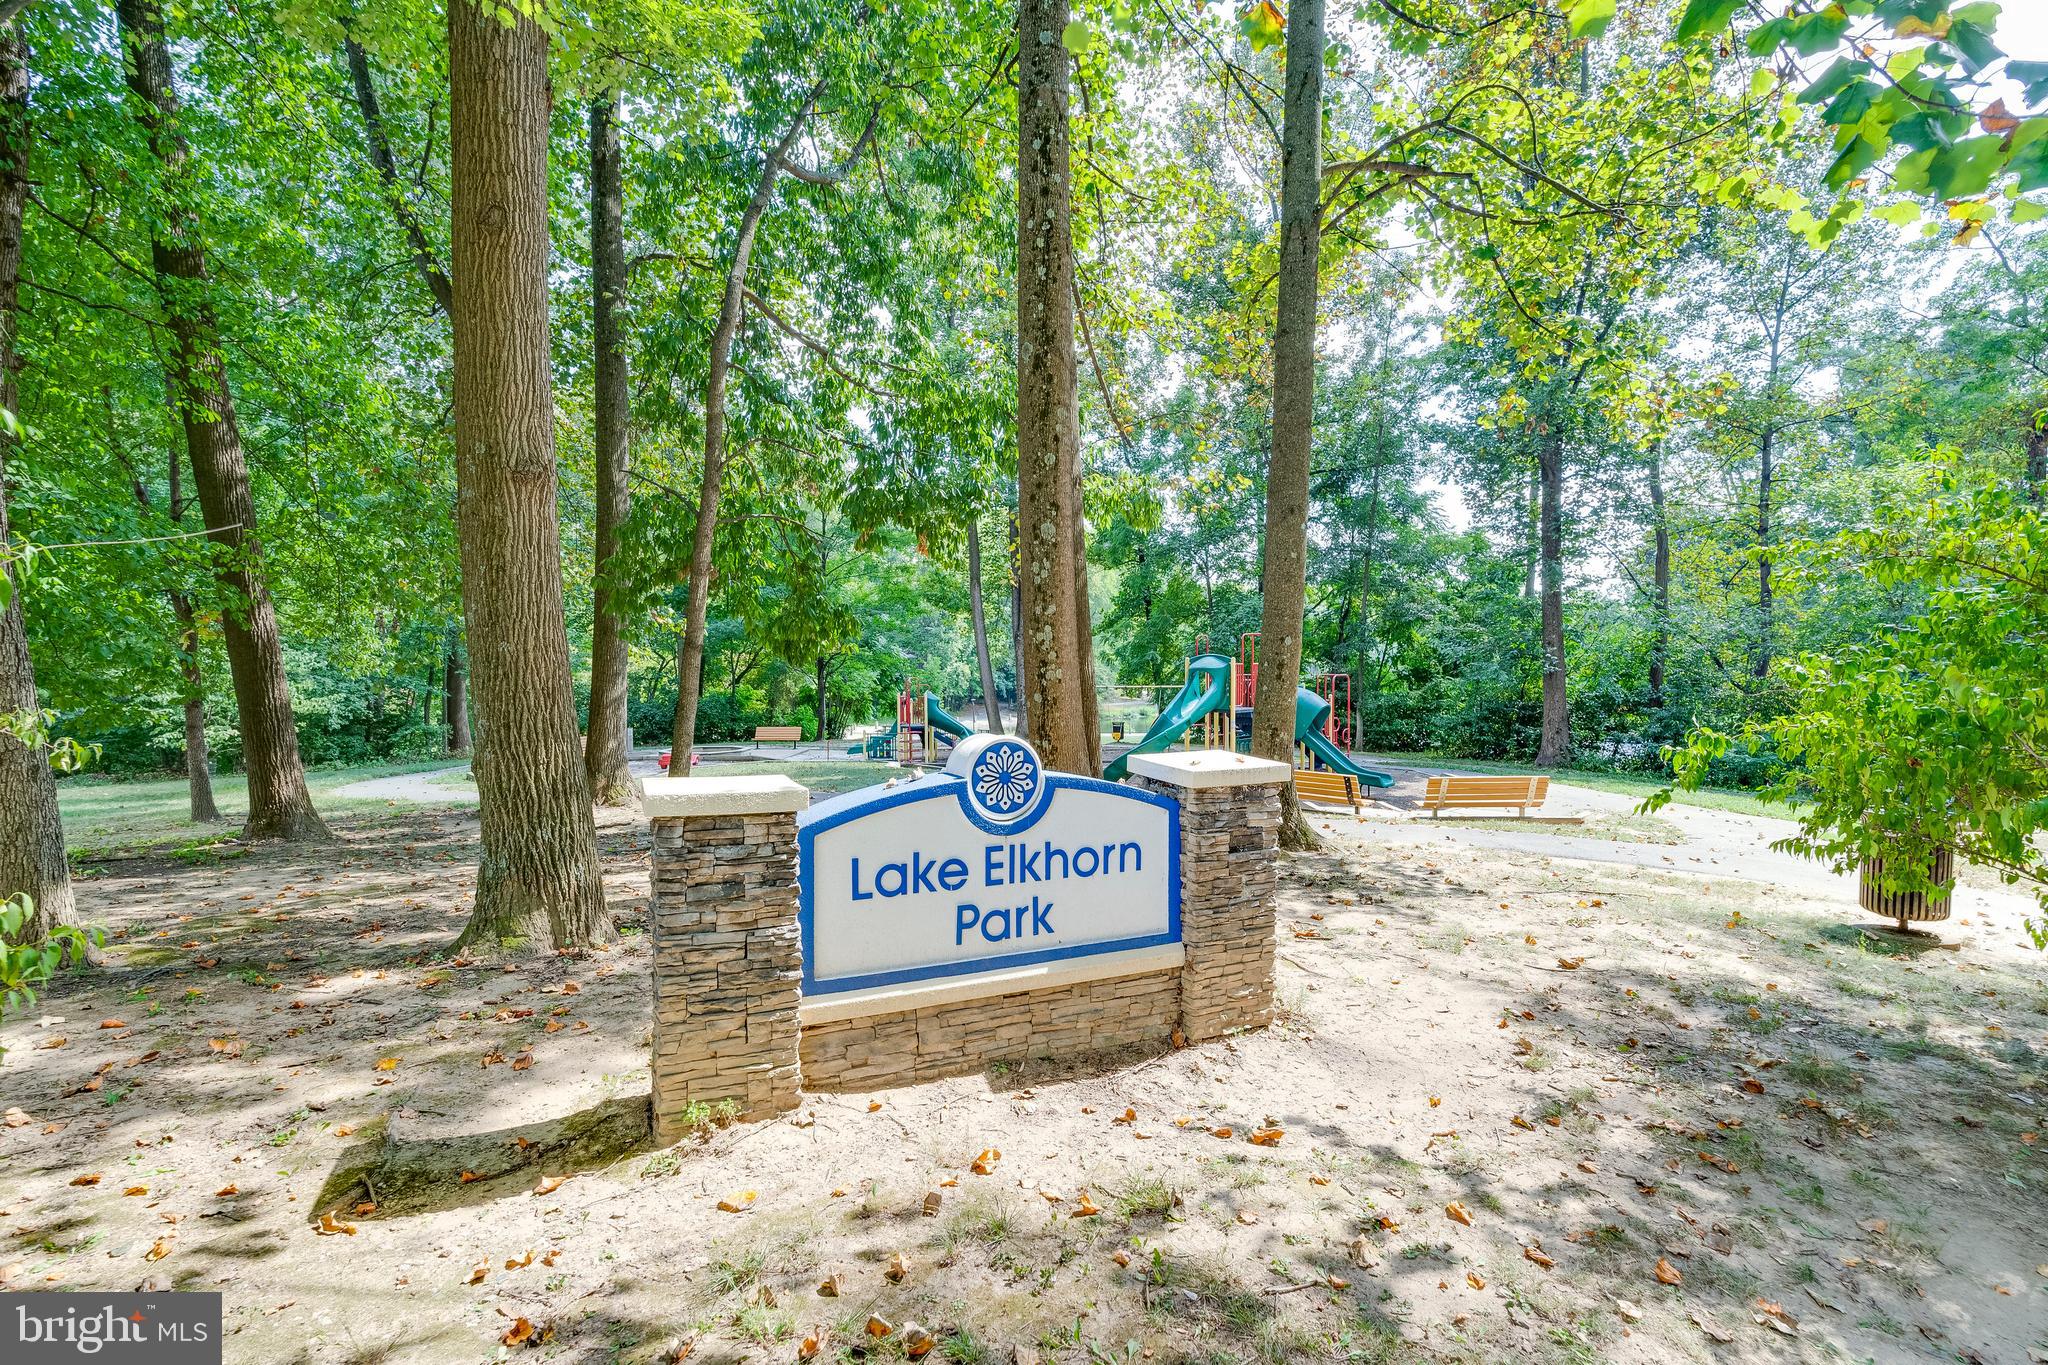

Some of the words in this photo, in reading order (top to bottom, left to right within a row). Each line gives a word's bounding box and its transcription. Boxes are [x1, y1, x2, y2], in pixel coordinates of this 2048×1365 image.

[851, 852, 969, 901] Lake
[985, 841, 1142, 887] Elkhorn
[955, 896, 1055, 946] Park
